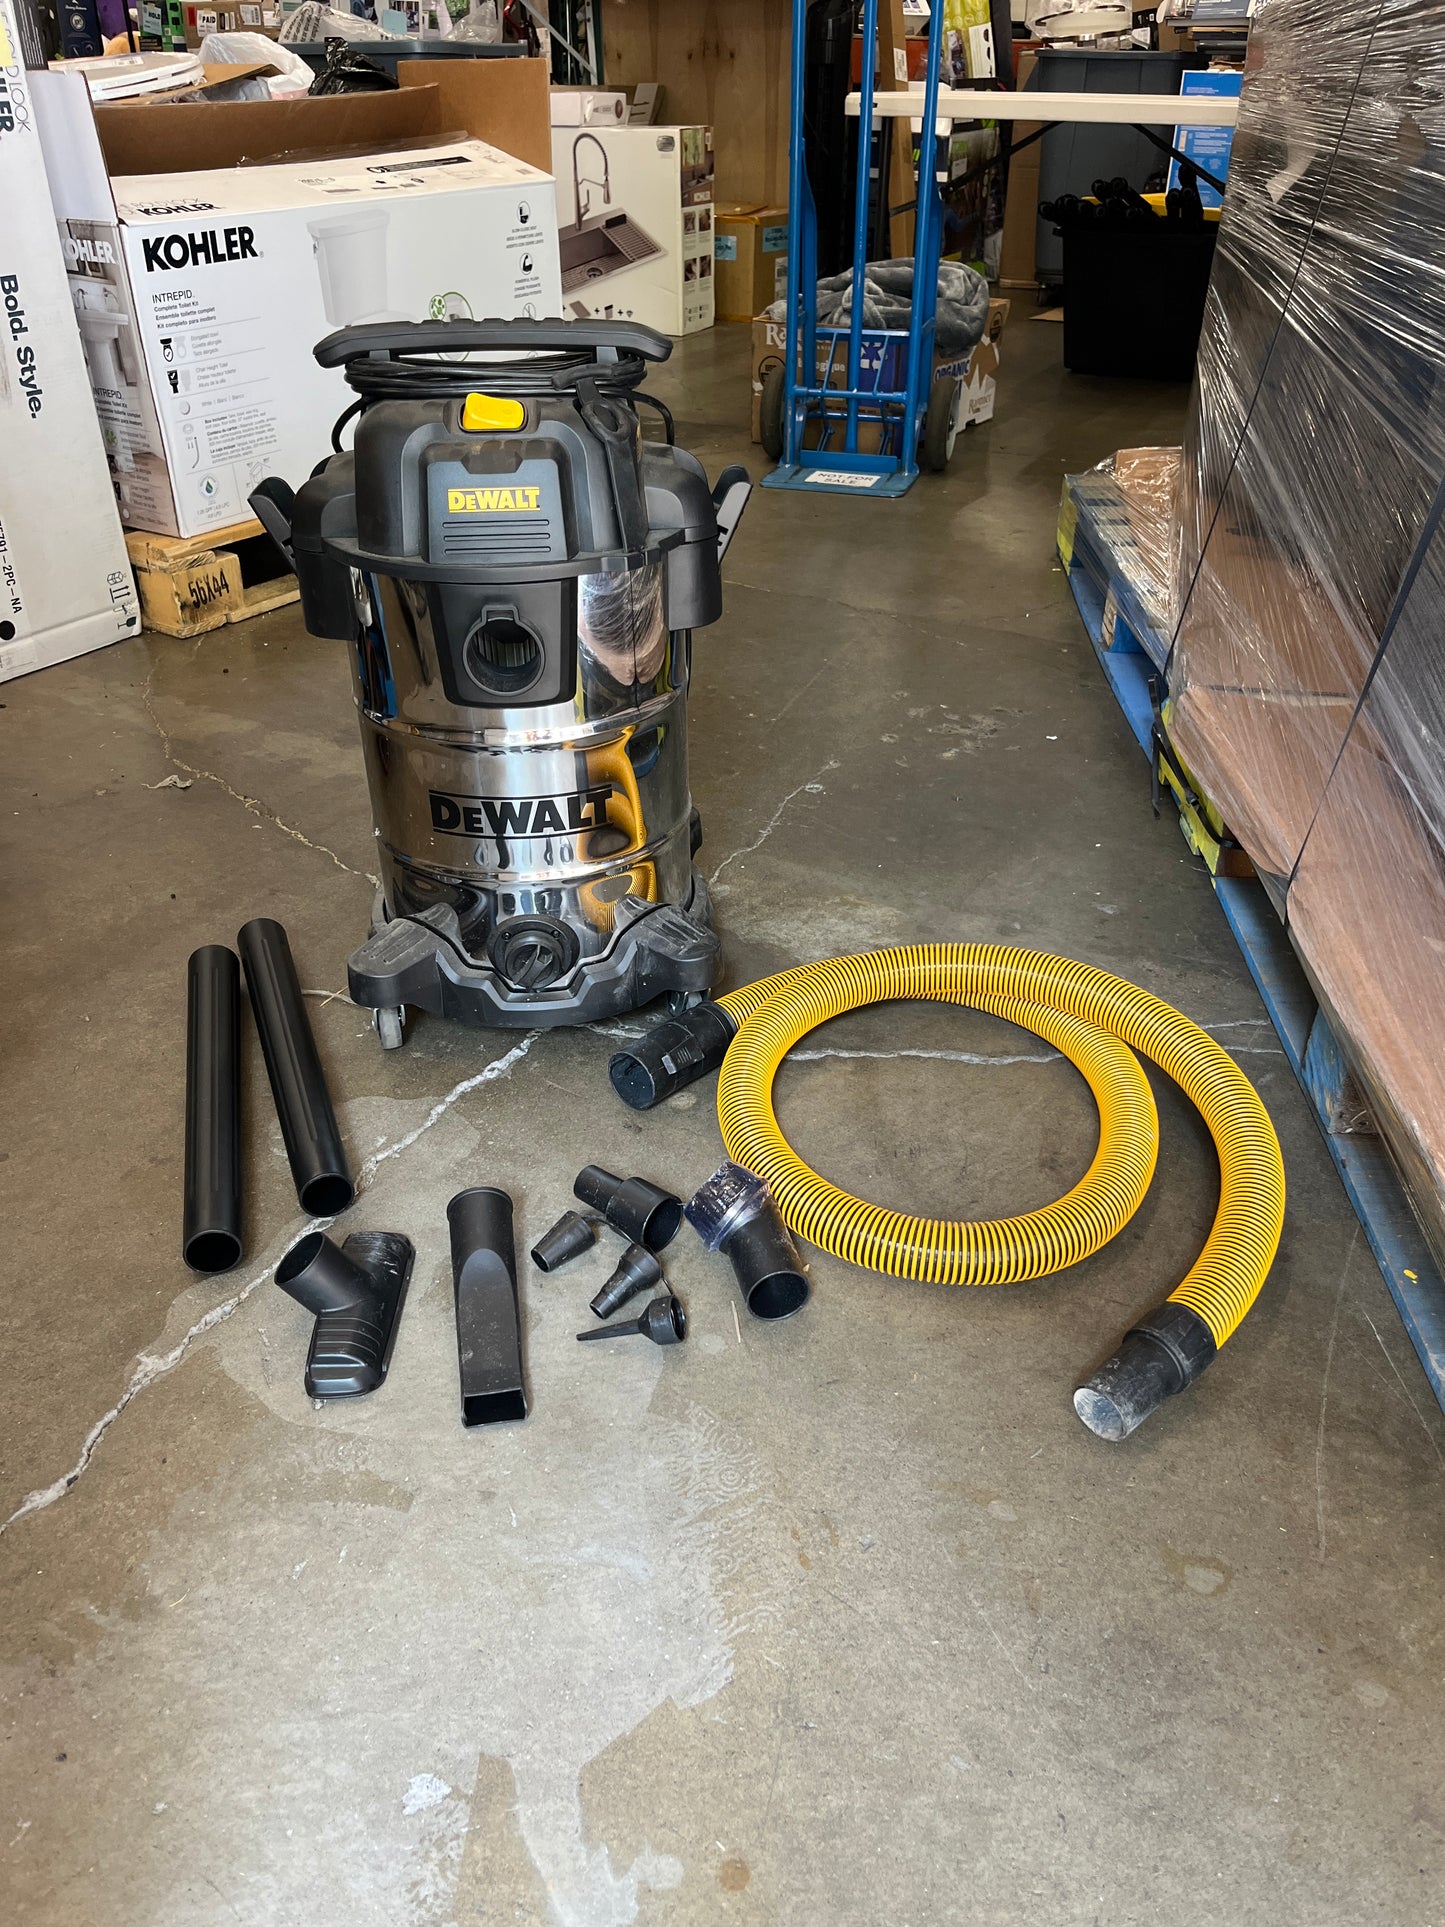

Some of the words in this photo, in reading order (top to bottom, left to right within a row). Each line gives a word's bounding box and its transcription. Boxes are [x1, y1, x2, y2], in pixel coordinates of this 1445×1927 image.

[202, 16, 216, 24] PAID
[137, 202, 219, 217] KOHLER
[142, 226, 259, 273] KOHLER
[152, 289, 194, 304] INTREPID
[0, 274, 29, 342] Bold.
[17, 346, 43, 420] Style.
